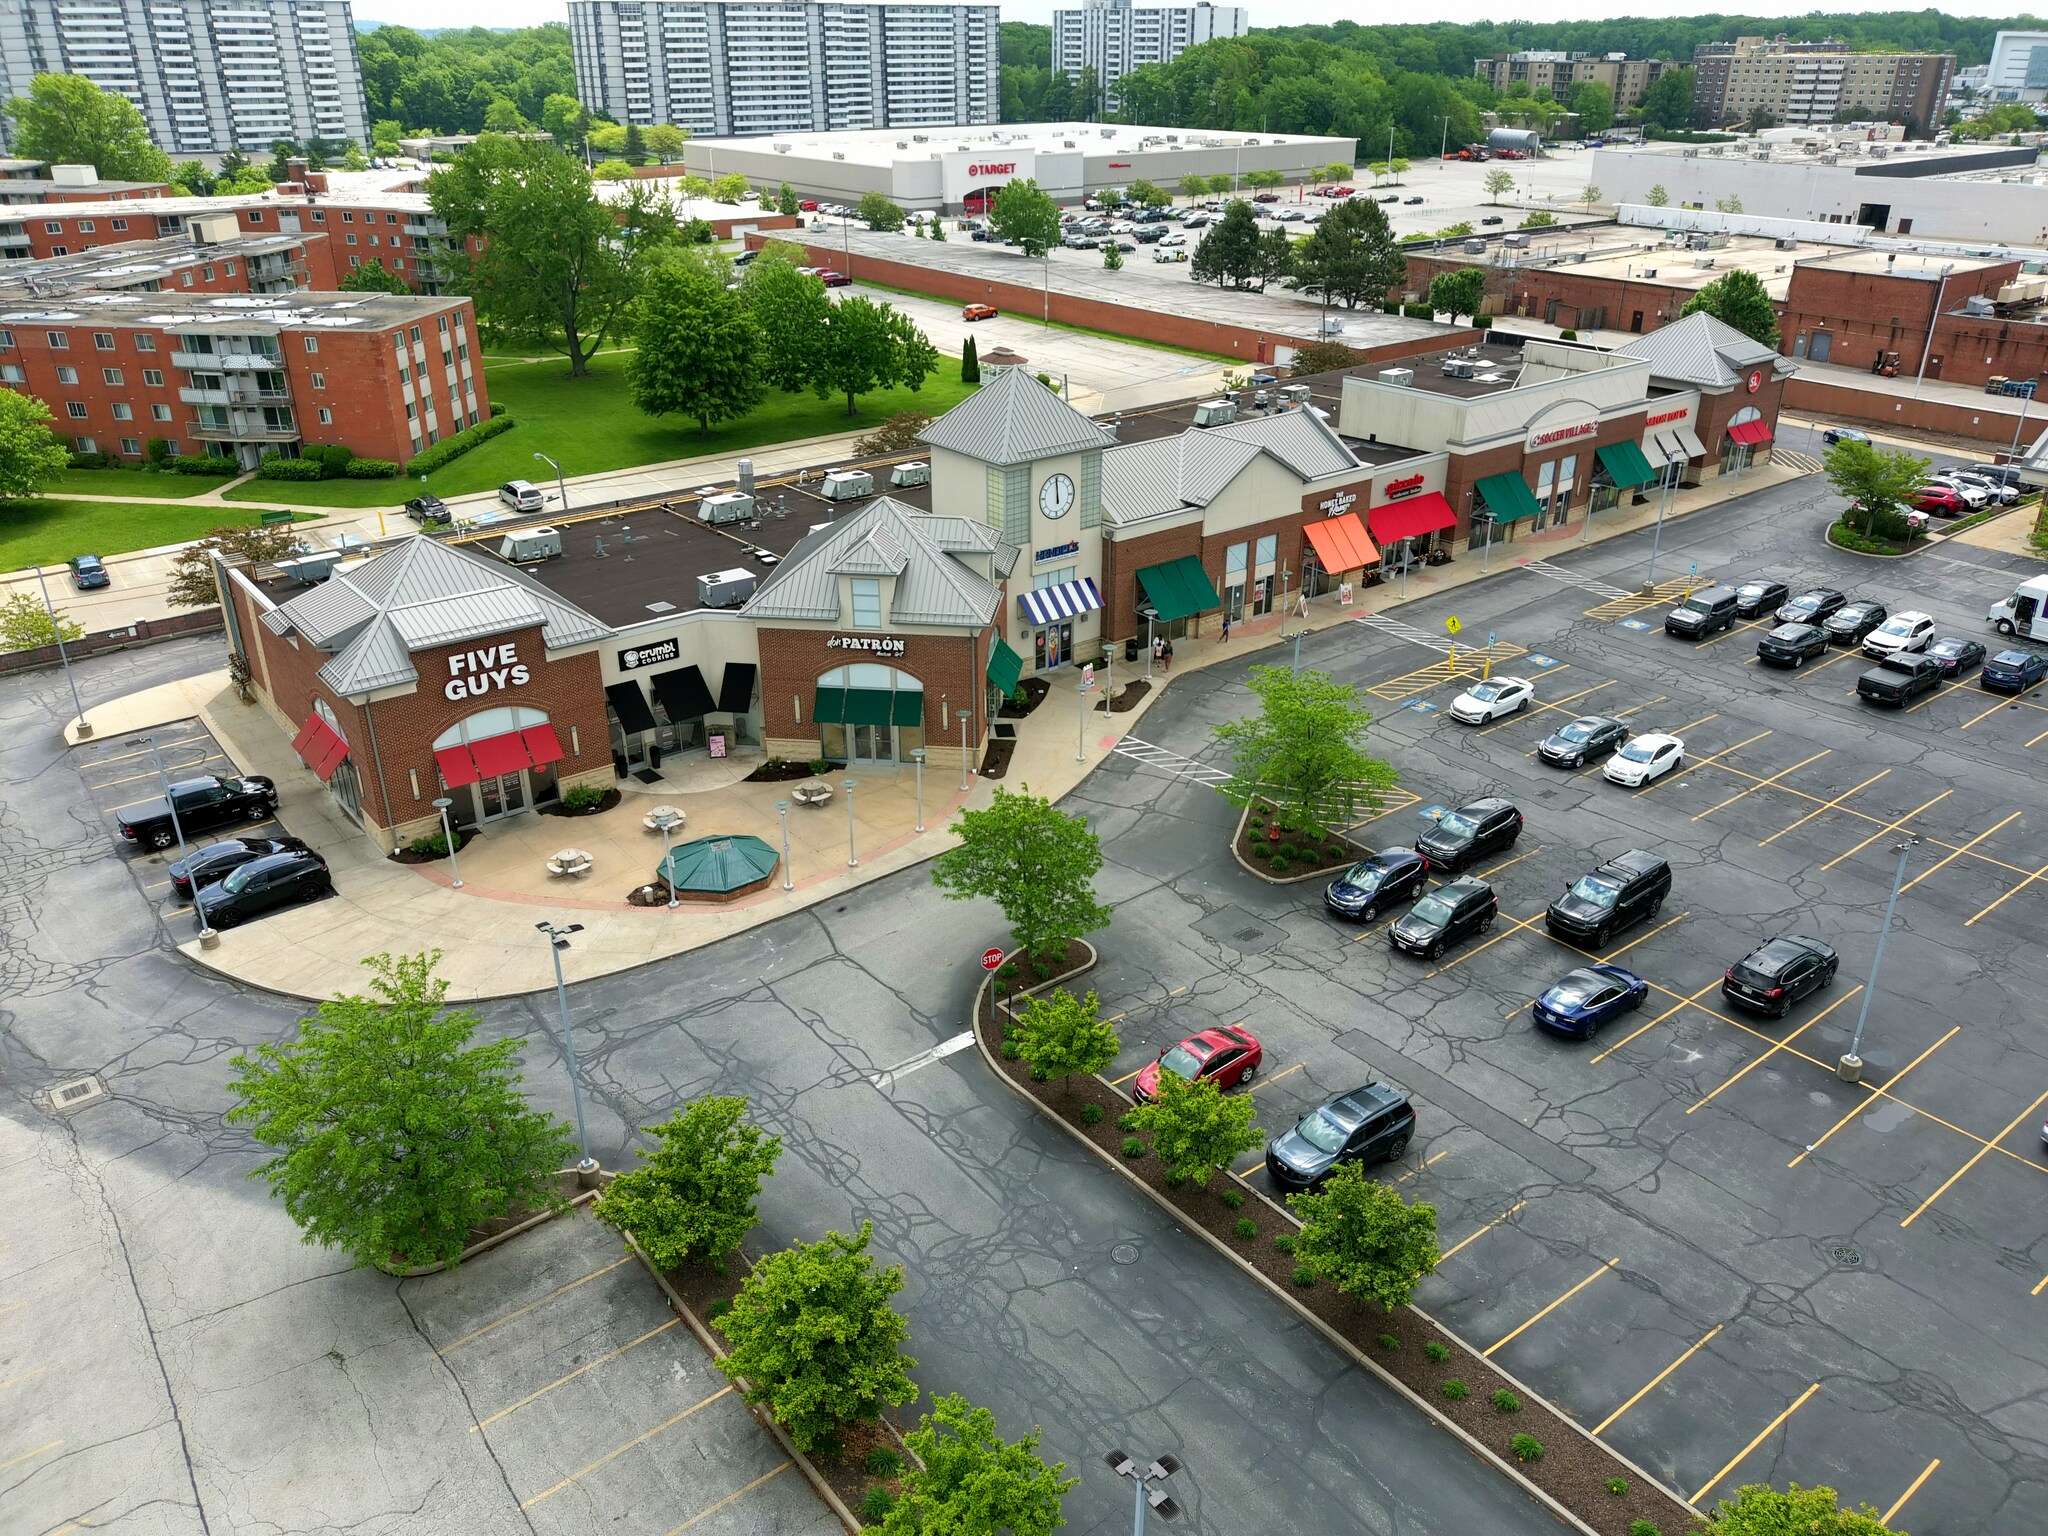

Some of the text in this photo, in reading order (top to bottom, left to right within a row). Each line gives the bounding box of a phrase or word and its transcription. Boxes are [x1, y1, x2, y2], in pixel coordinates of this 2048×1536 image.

[978, 163, 1016, 175] TARGET
[1541, 422, 1592, 444] SOCCER VILLAGE
[639, 642, 676, 659] crumbl
[827, 635, 904, 651] don PATRÓN
[448, 643, 518, 676] FIVE
[642, 652, 674, 664] cookies
[445, 664, 530, 701] GUYS
[983, 953, 1002, 965] STOP
